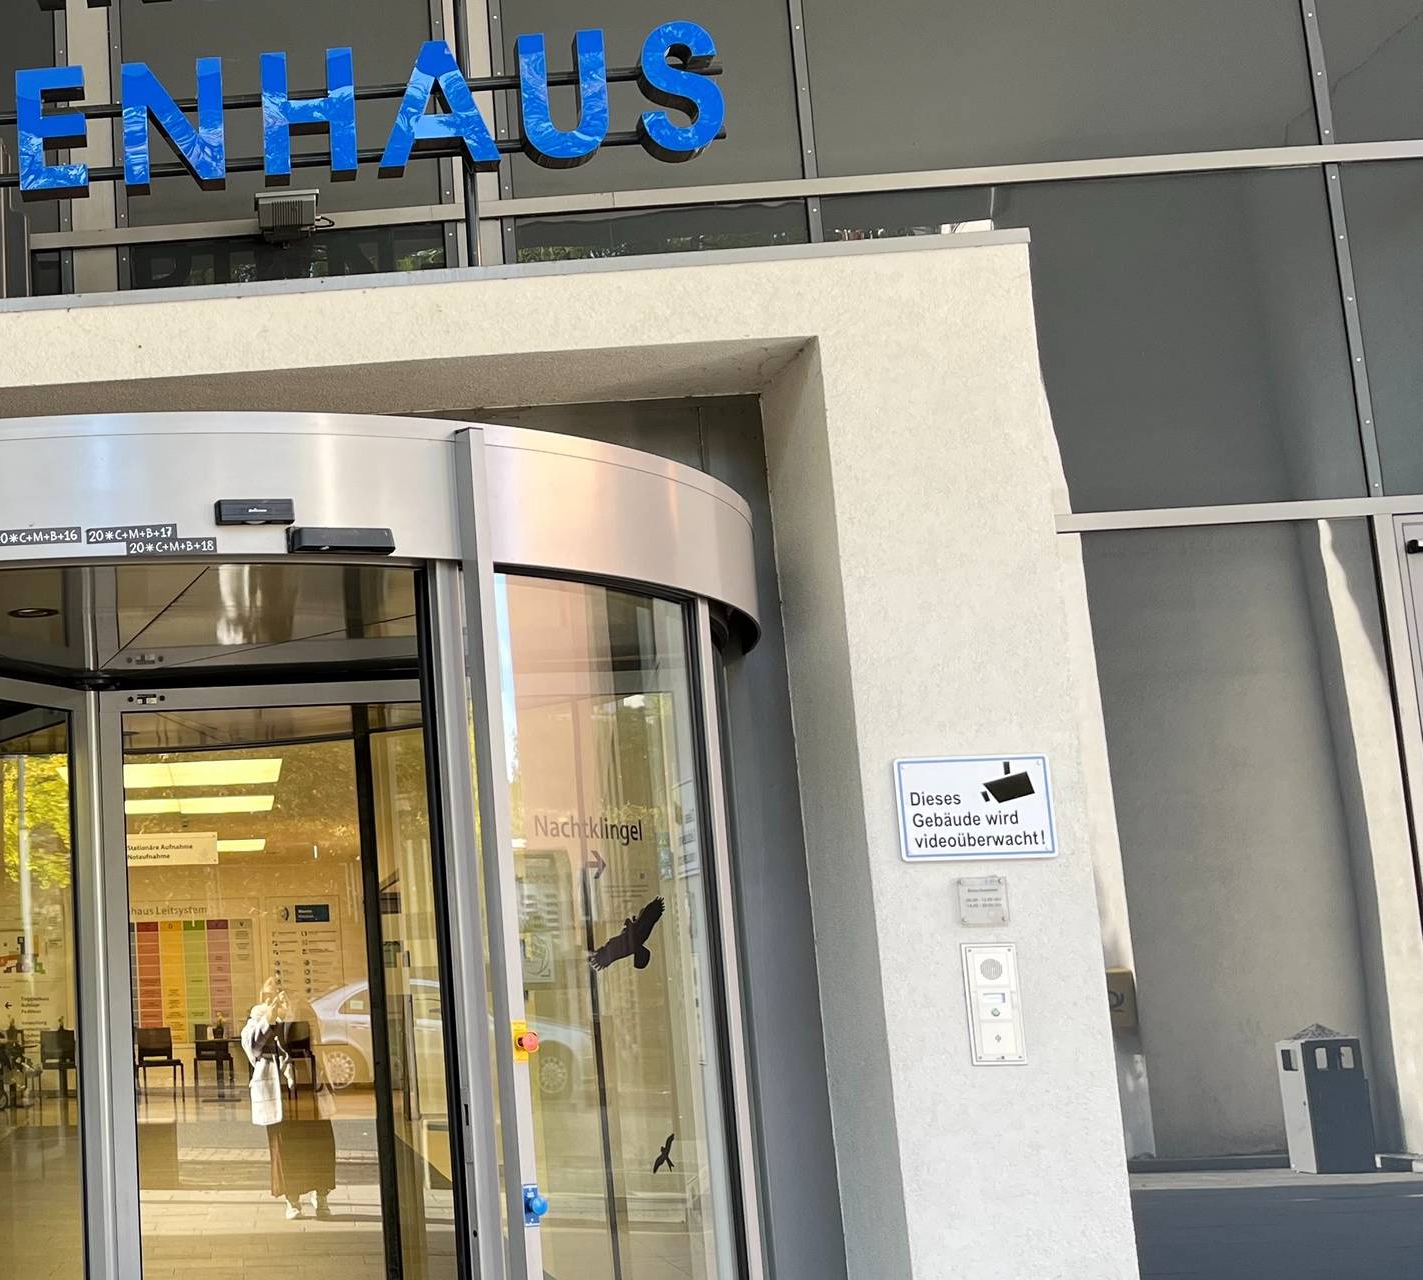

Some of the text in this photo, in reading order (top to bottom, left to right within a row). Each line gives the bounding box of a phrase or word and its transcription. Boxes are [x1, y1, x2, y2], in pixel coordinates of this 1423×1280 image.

[910, 791, 962, 806] Dieses
[912, 810, 1019, 828] Gebäude wird
[534, 815, 643, 846] Nachtklingel
[914, 829, 1046, 849] videoüberwacht!
[130, 906, 207, 916] haus Leitsystem
